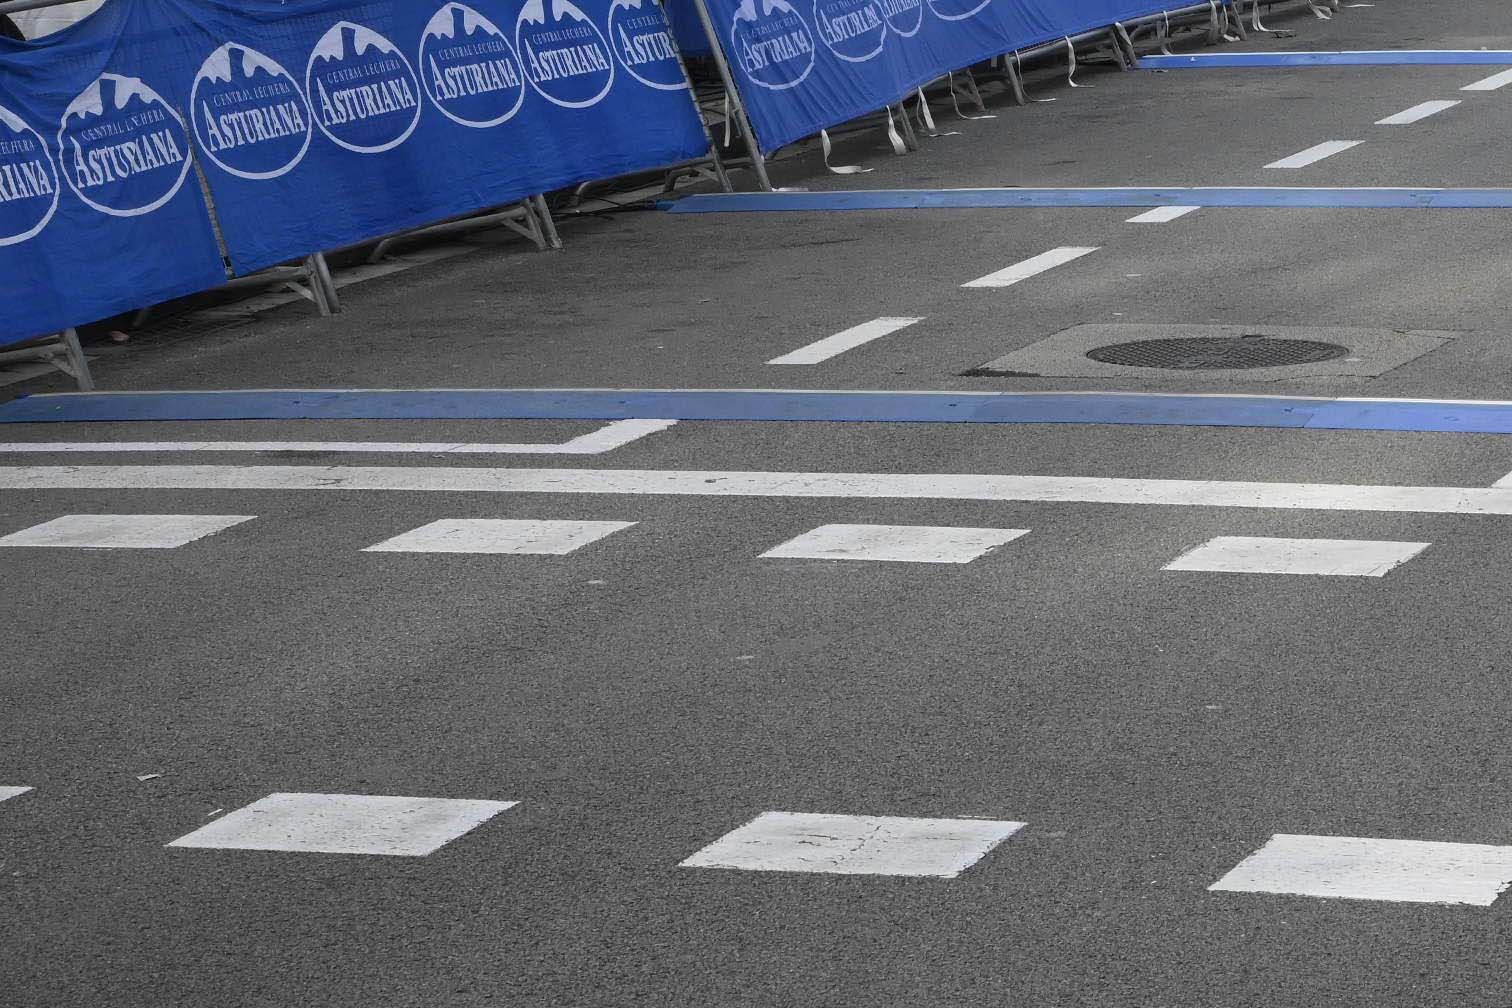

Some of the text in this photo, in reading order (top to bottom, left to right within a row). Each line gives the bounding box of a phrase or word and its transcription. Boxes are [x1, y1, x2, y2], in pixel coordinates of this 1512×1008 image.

[326, 58, 401, 84] CENTRAL LECHERA
[438, 45, 472, 61] CENTRAL
[524, 38, 610, 83] ASTURIANA
[429, 53, 521, 102] ASTURIANA
[316, 76, 417, 127] ASTURIANA
[202, 100, 307, 153] ASTURIANA
